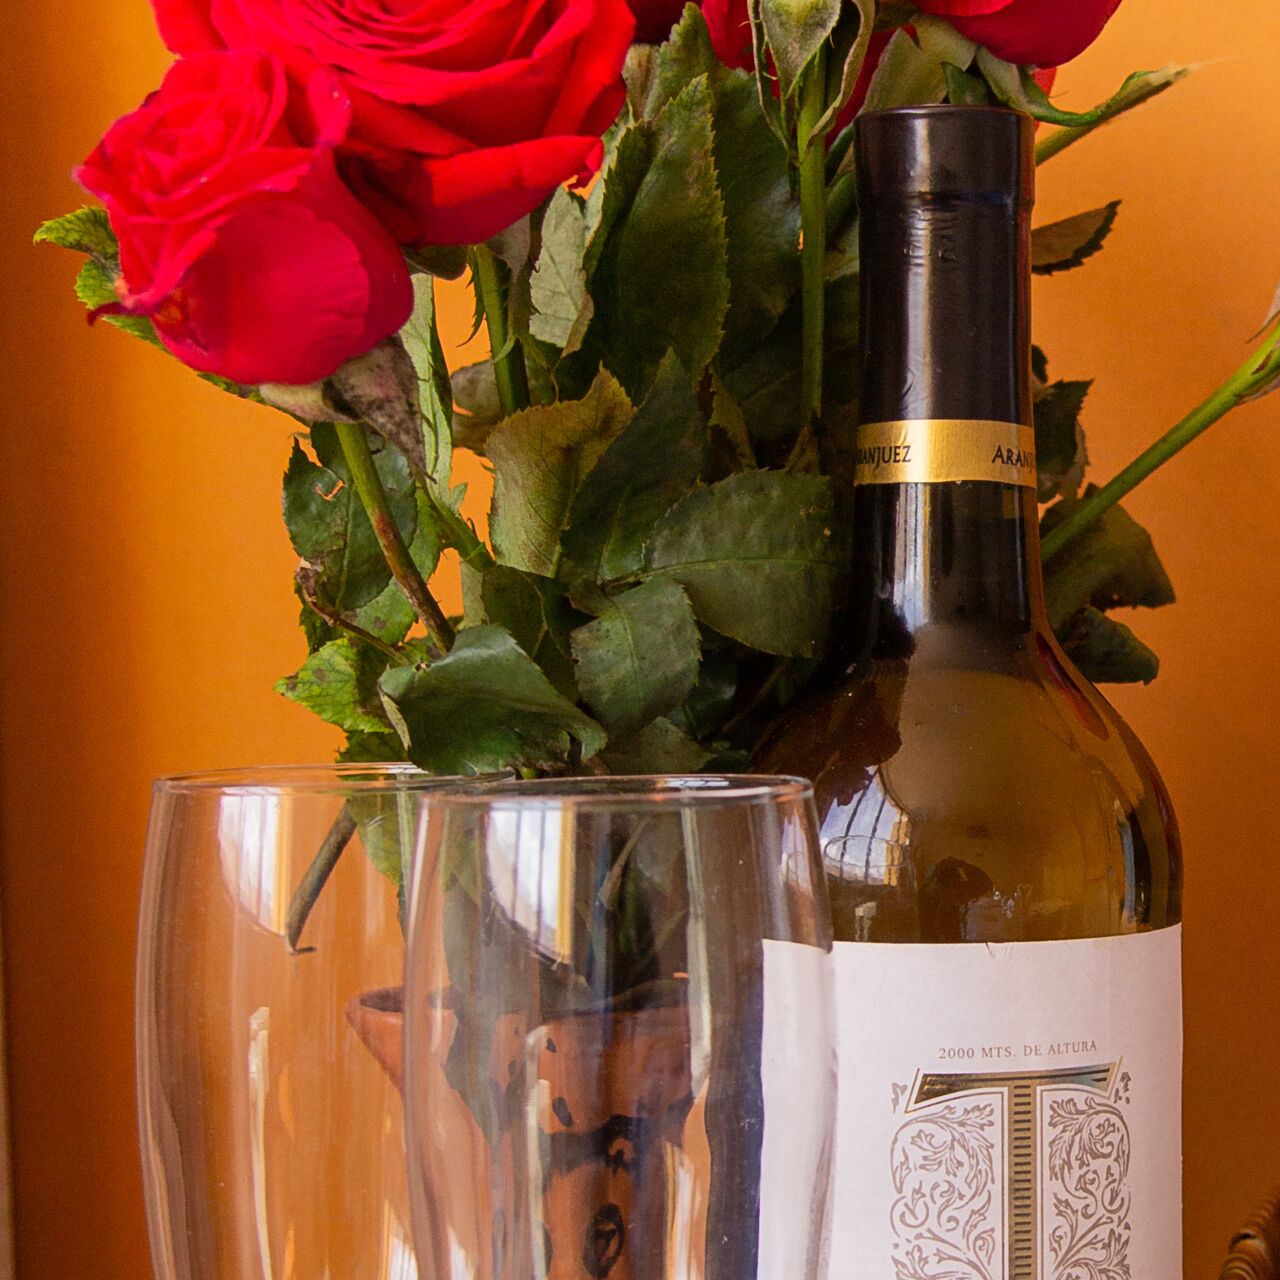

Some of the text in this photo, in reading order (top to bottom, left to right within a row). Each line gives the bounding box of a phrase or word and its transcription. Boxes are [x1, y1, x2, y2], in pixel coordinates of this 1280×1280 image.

[938, 1039, 1098, 1060] 2000 MTS. DE ALTURA
